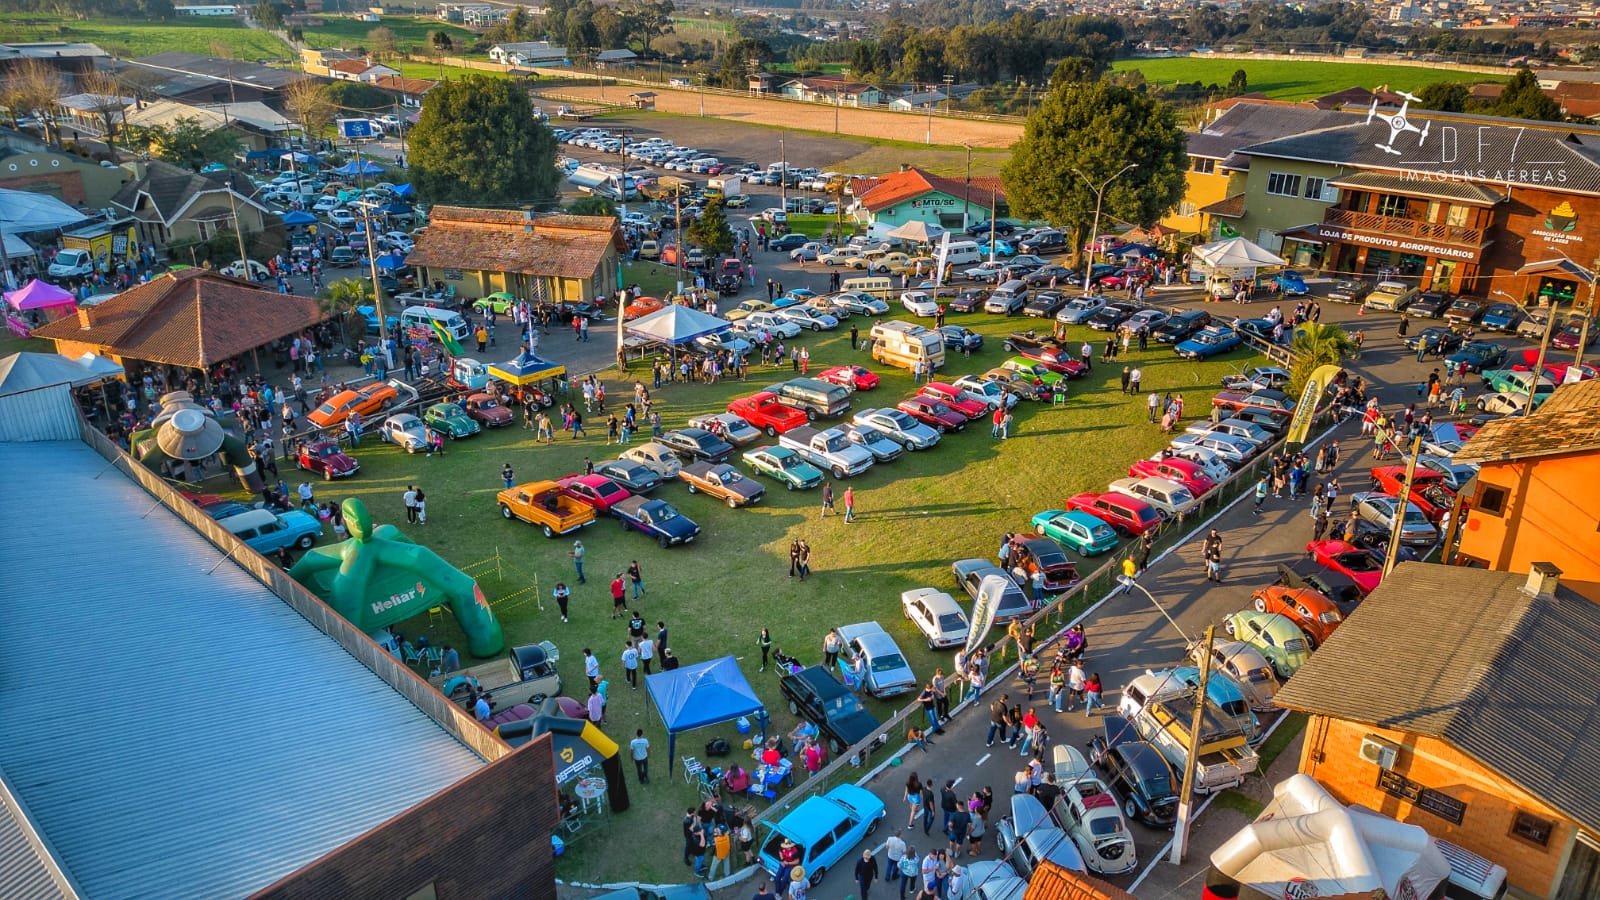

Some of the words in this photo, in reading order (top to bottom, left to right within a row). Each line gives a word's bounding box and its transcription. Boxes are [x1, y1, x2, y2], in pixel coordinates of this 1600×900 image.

[1319, 229, 1340, 239] LOJA
[1341, 232, 1353, 241] DE
[1353, 234, 1399, 248] PRODUTOS
[1399, 241, 1475, 260] AGROPECUÁRIOS
[371, 590, 416, 615] Heliar
